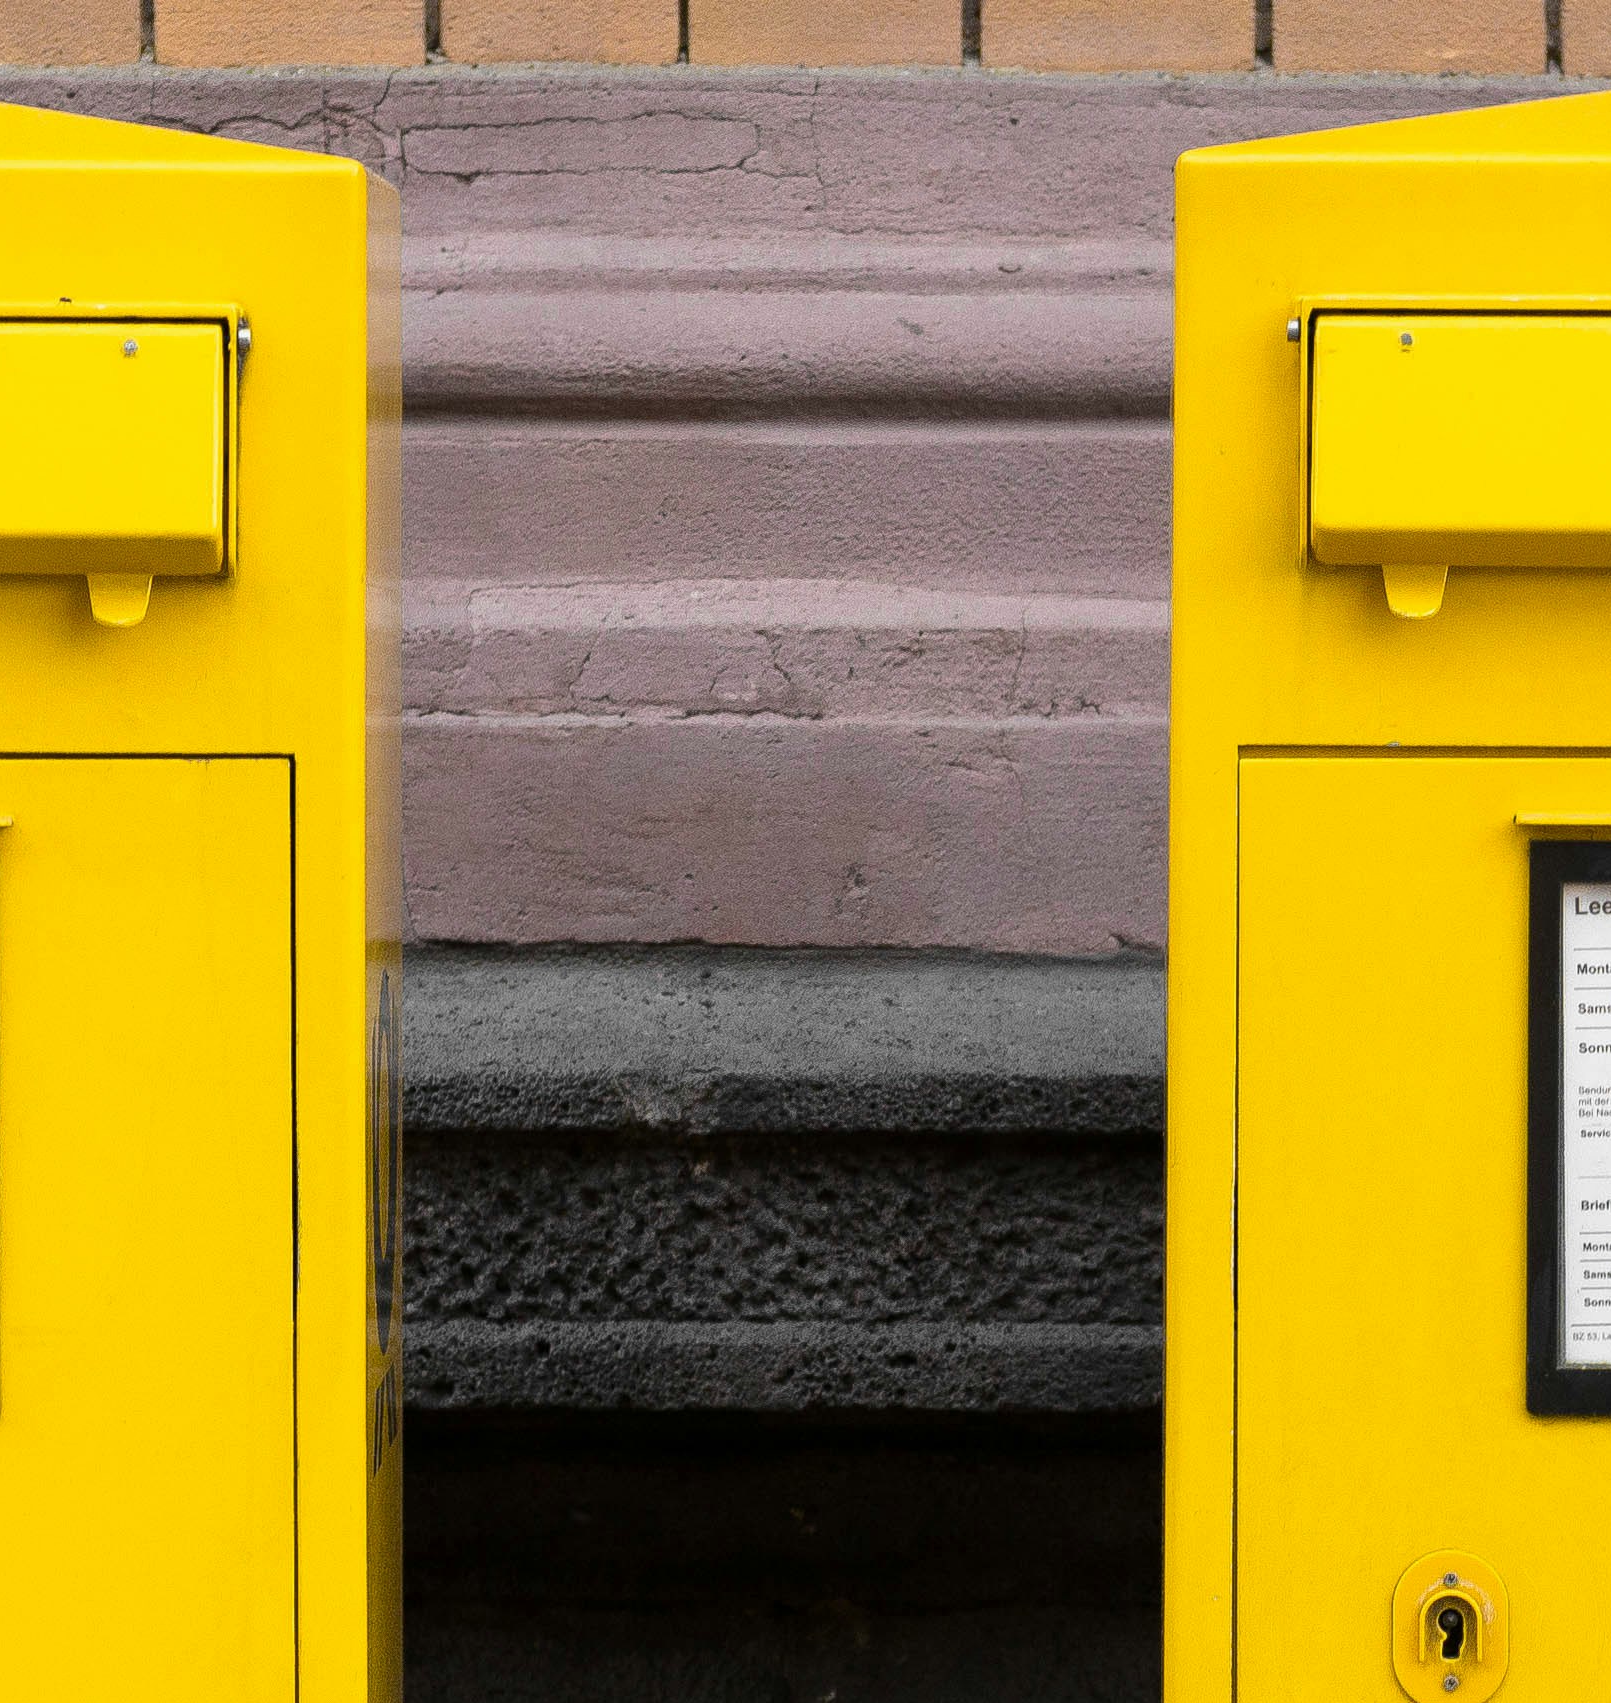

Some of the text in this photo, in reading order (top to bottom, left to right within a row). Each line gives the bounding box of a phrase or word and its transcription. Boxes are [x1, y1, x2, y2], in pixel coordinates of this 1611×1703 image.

[1579, 1097, 1592, 1106] mit
[1595, 1097, 1609, 1105] der
[1579, 1109, 1593, 1117] Bei
